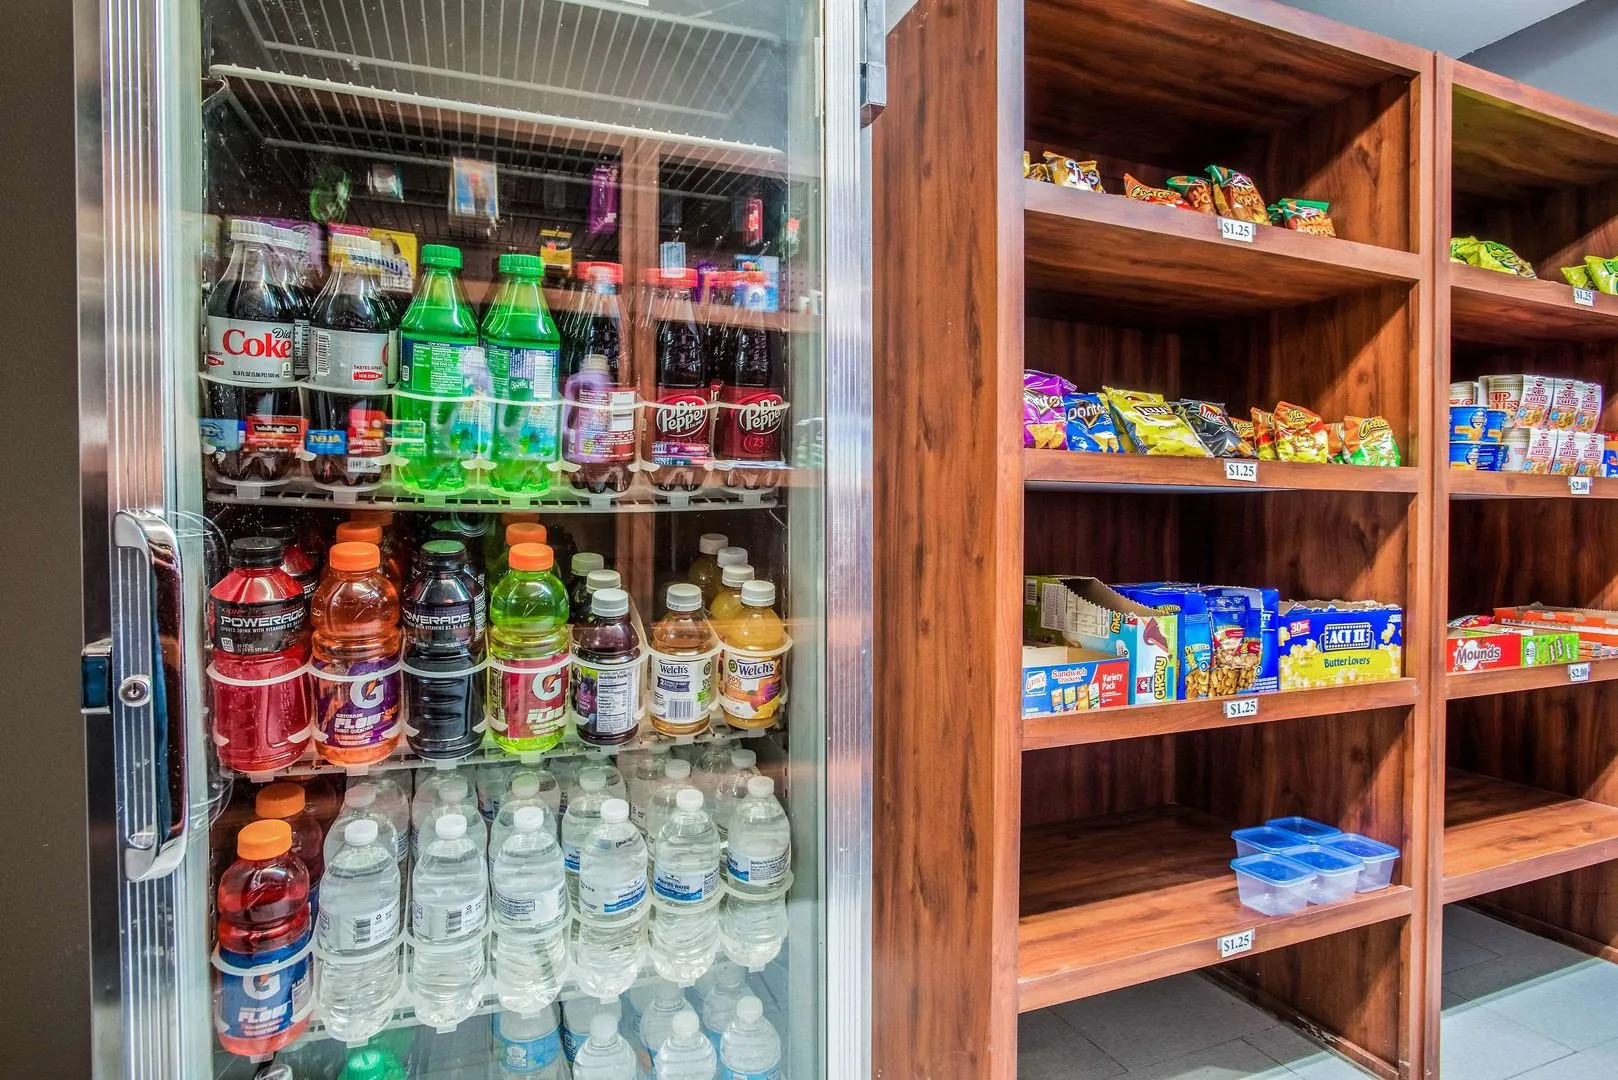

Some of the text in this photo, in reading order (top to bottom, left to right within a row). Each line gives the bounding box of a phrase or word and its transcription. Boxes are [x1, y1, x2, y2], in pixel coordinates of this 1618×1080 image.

[1223, 223, 1250, 237] $1.25
[1575, 290, 1592, 301] $1.25
[272, 328, 292, 339] Diet
[222, 328, 292, 358] Coke
[674, 400, 696, 417] Dr
[760, 400, 777, 414] Dr
[661, 404, 706, 433] Pepper
[752, 438, 765, 447] 23
[1228, 464, 1254, 477] $1.25
[1571, 482, 1588, 491] $2.00
[220, 606, 305, 628] POWERADE
[402, 606, 471, 625] OWERADE
[1290, 622, 1301, 634] 30
[1329, 628, 1366, 645] ACT II
[1324, 655, 1370, 668] Butter Lovers
[1455, 646, 1501, 663] Mounds
[660, 664, 689, 674] Welch's
[738, 662, 774, 676] Welch's
[1052, 667, 1088, 678] Sandwich
[532, 666, 562, 701] G
[1102, 673, 1123, 682] Variety
[350, 671, 385, 709] G
[1101, 682, 1116, 691] Pack
[1230, 700, 1256, 715] $1.25
[1223, 934, 1250, 952] $1.25
[243, 973, 280, 1000] G
